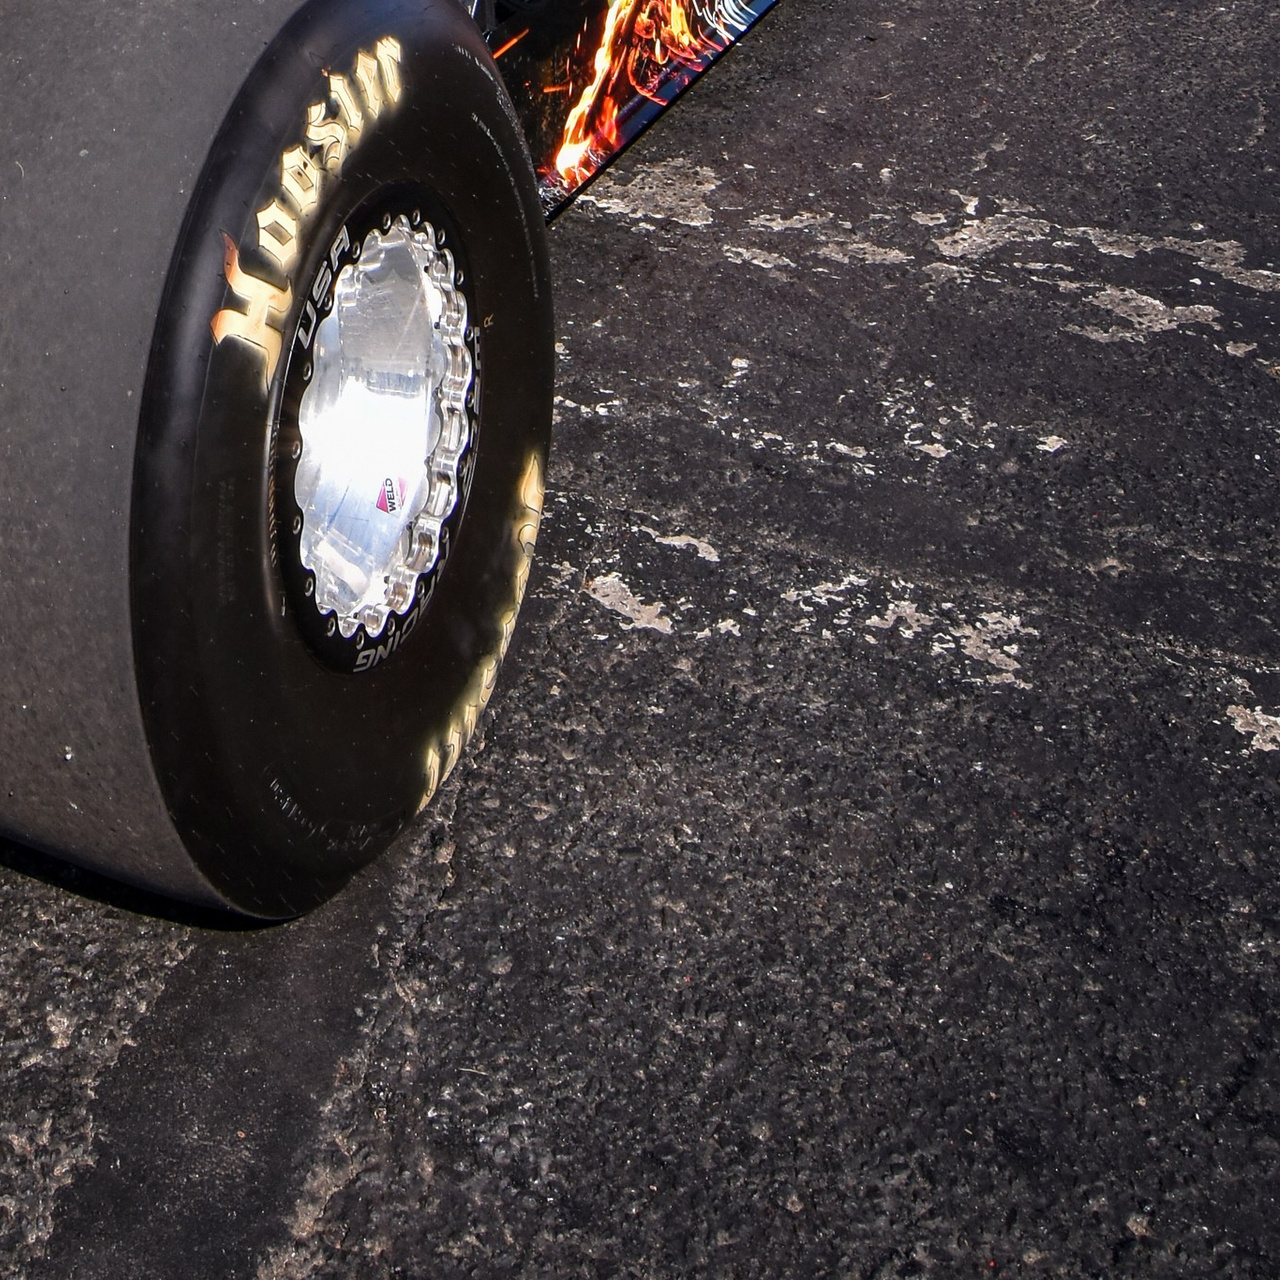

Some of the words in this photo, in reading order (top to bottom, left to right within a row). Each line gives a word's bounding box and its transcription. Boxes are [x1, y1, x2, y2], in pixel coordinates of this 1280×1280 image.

[210, 36, 403, 392] Hoosier
[297, 224, 351, 351] USA
[385, 477, 397, 513] WELD
